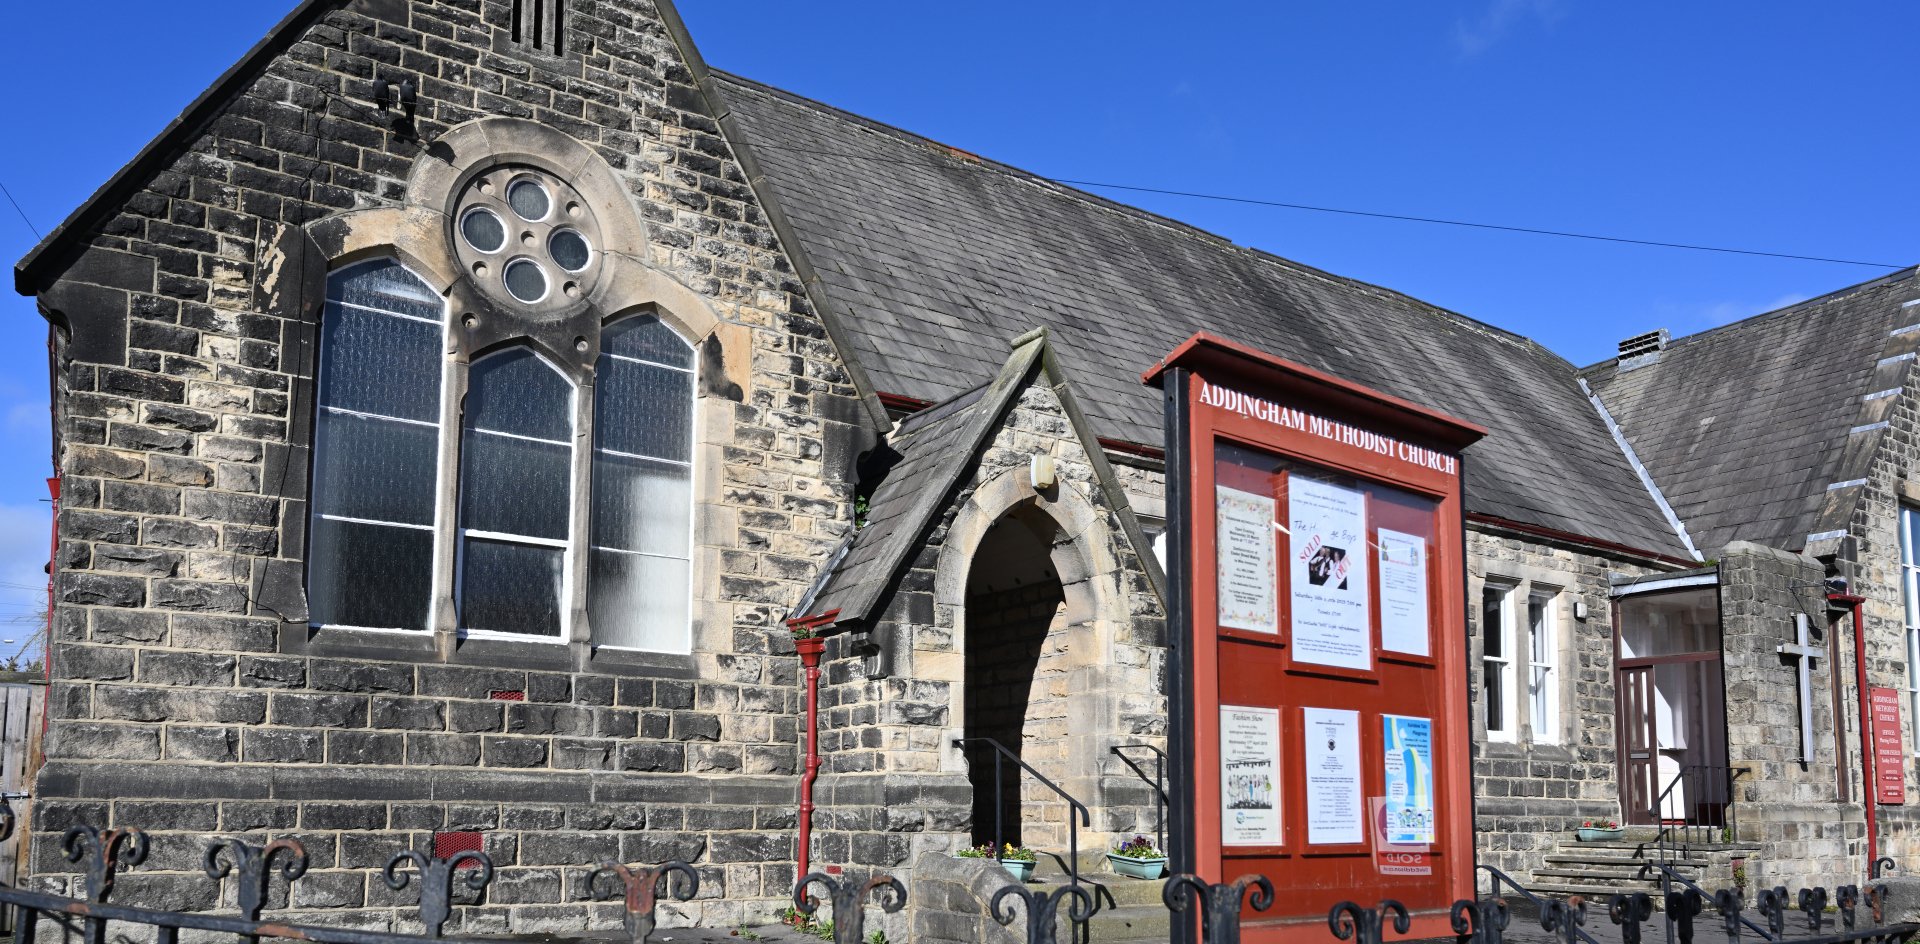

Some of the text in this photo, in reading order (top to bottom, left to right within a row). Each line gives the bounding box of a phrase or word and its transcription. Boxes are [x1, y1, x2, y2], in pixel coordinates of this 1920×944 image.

[1199, 381, 1456, 475] ADDINGHAM METHODIST CHURCH
[1299, 534, 1321, 564] SOLD
[1232, 712, 1263, 722] Fashion Show
